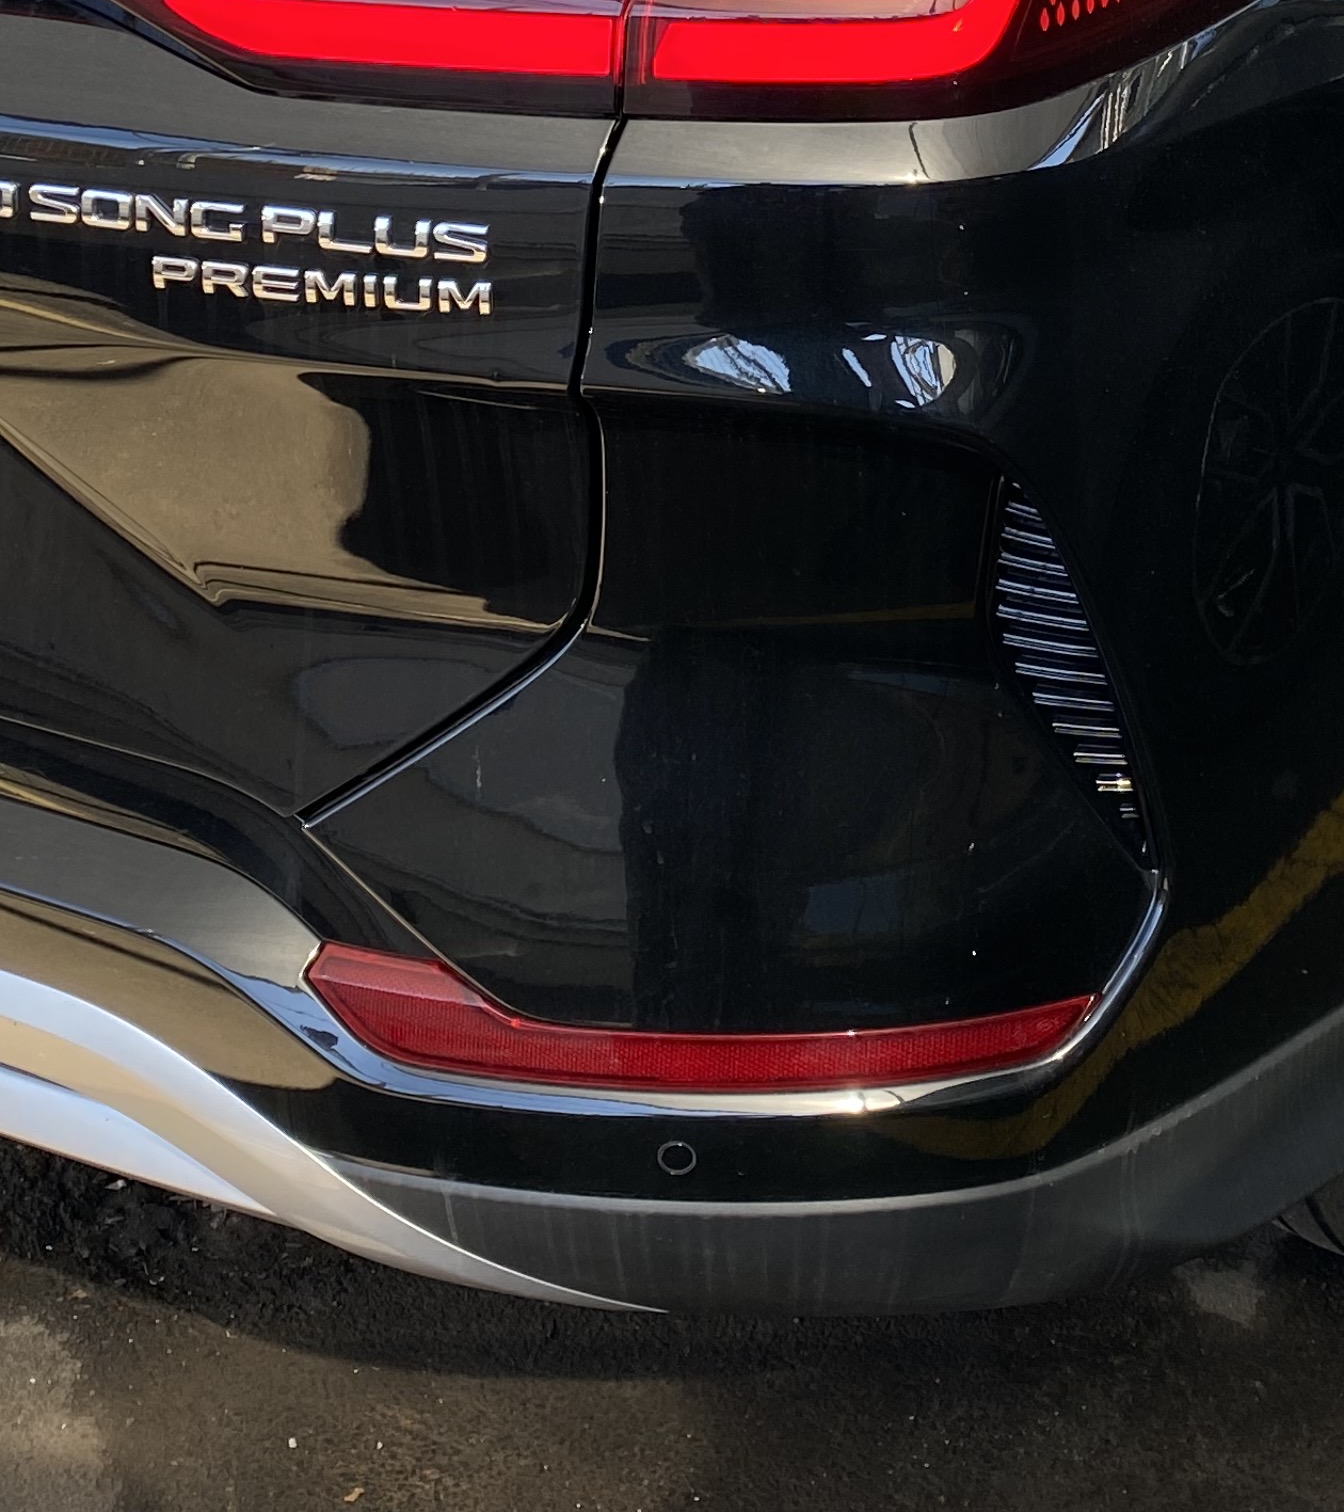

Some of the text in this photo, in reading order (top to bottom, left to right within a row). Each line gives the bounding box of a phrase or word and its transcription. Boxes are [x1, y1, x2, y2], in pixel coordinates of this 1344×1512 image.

[29, 186, 247, 243] SONG
[260, 205, 491, 264] PLUS
[152, 255, 493, 316] PREMIUM
